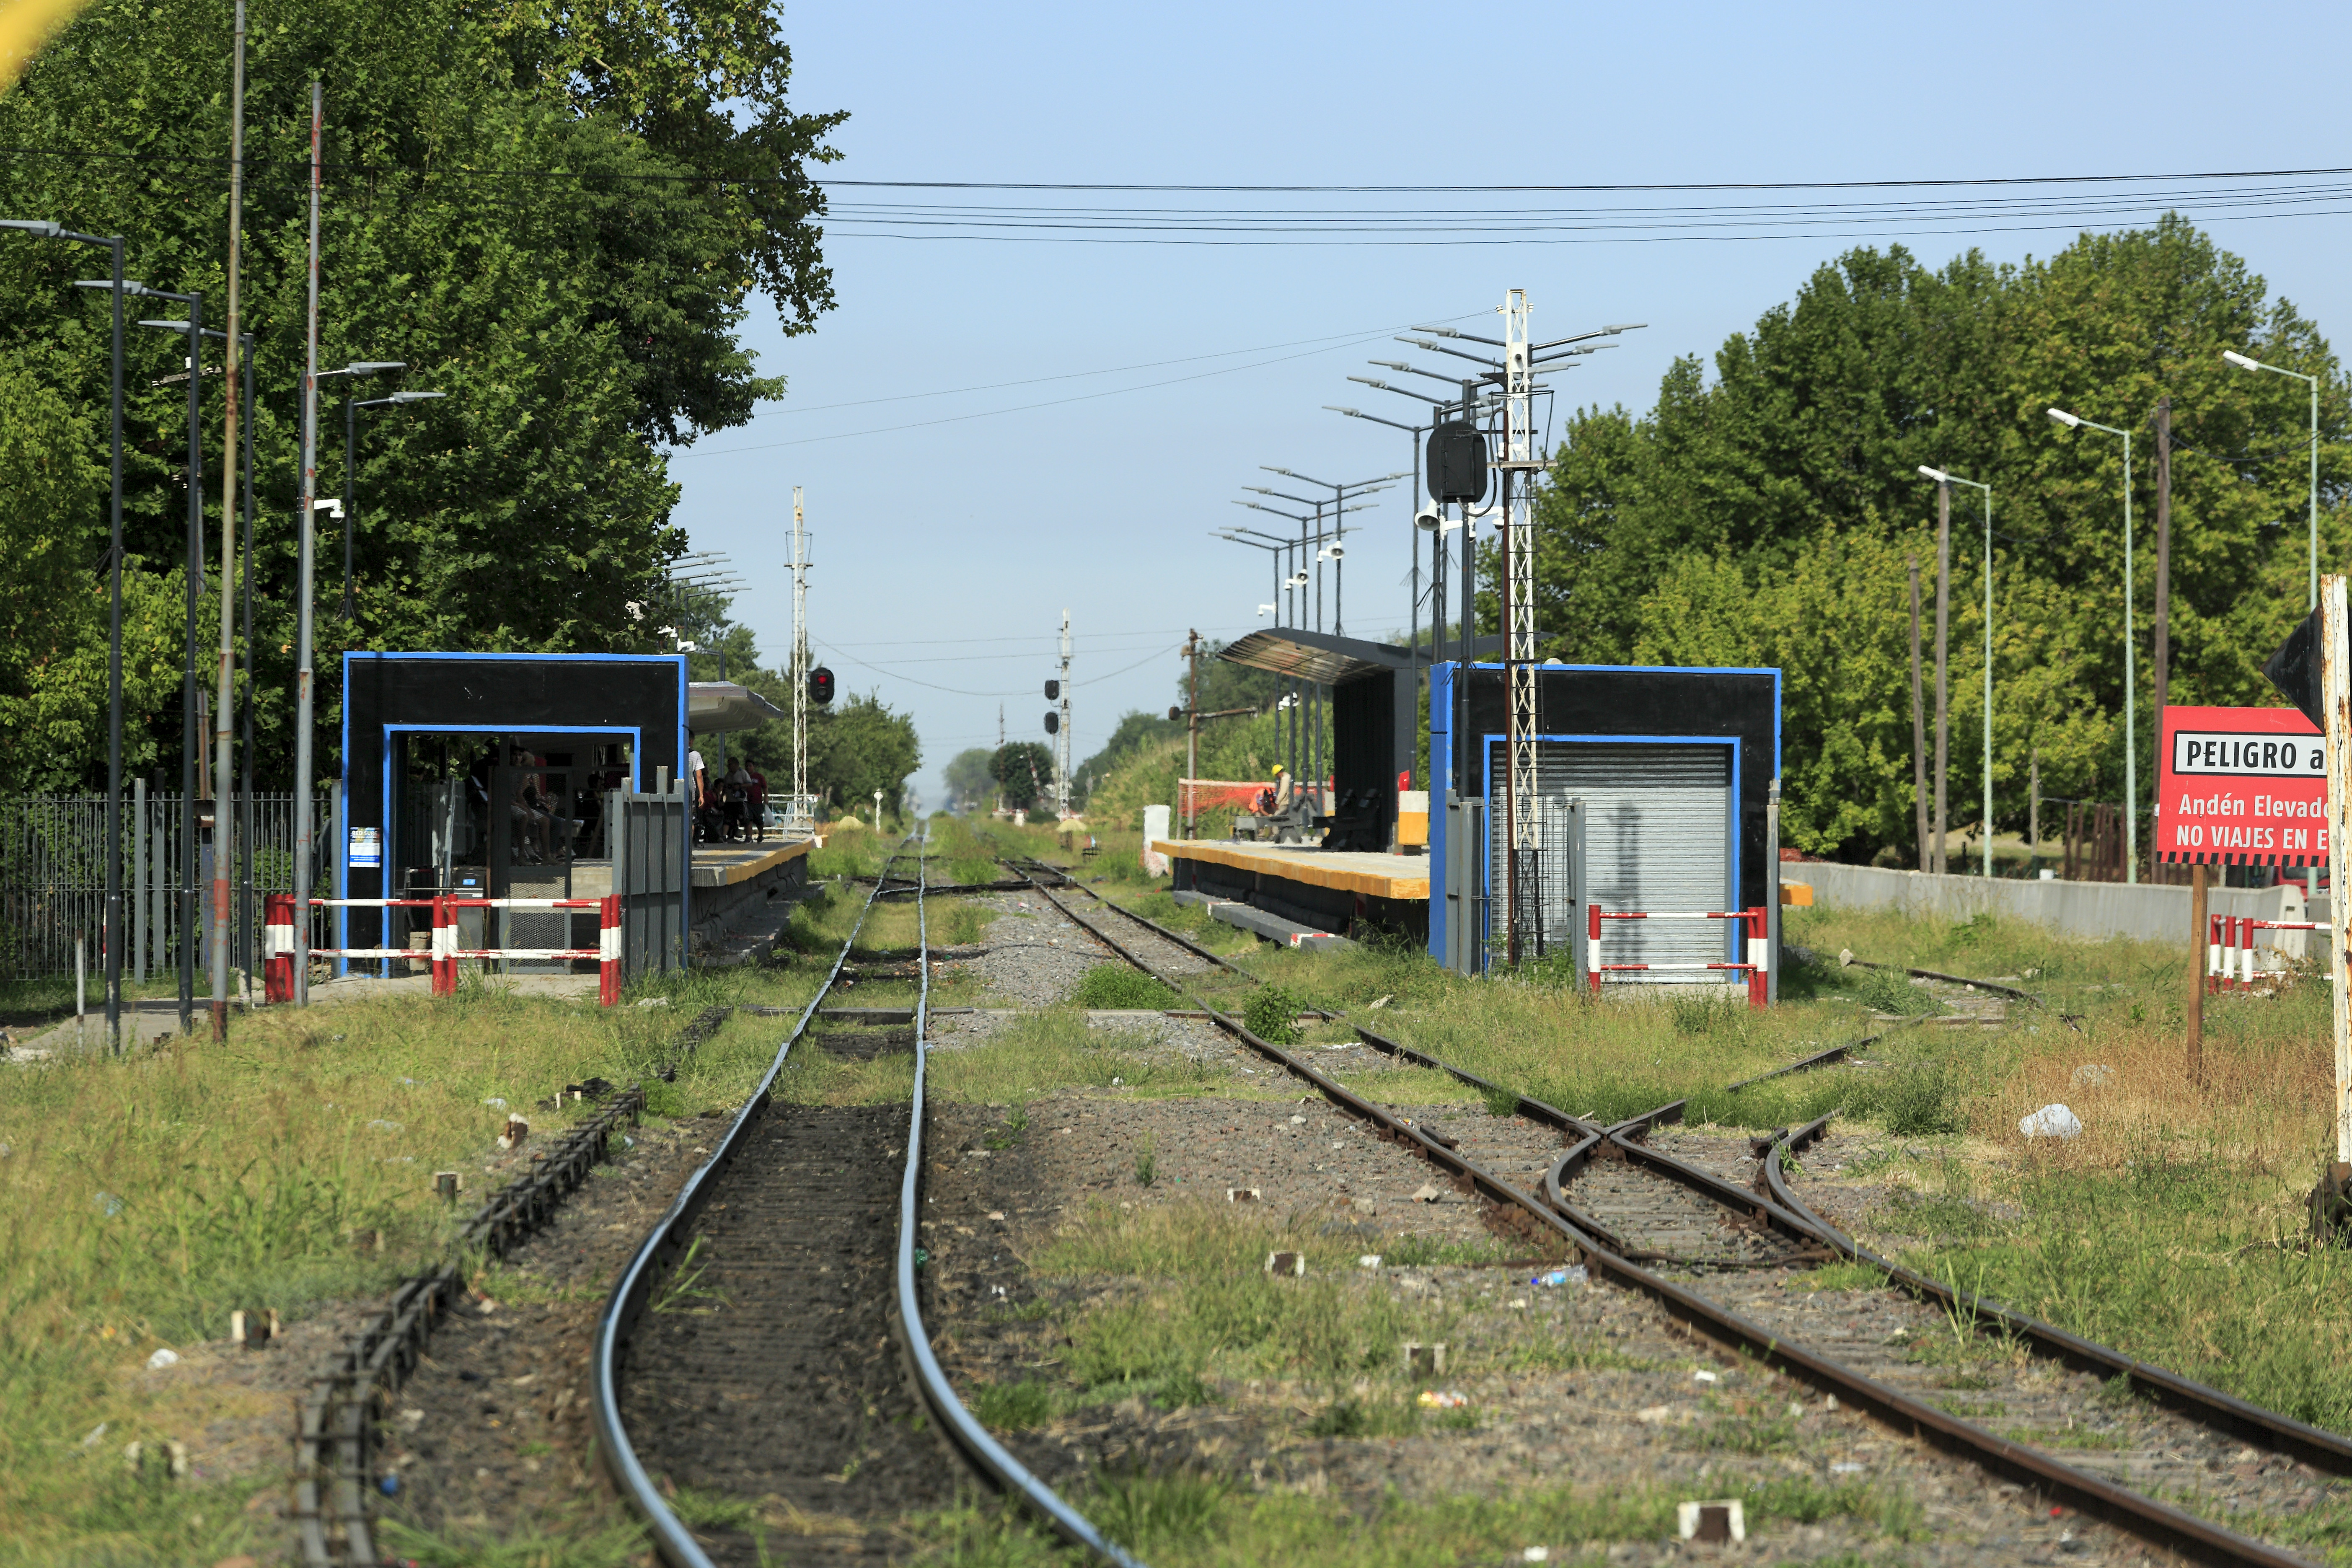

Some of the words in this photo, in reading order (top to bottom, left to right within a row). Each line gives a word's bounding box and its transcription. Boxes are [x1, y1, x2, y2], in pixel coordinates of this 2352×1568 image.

[2187, 741, 2296, 769] PELIGRO
[2179, 793, 2245, 815] Andén
[2177, 825, 2203, 846] NO
[2211, 826, 2274, 849] VIAJES
[2283, 828, 2307, 849] EN
[2317, 829, 2329, 850] E
